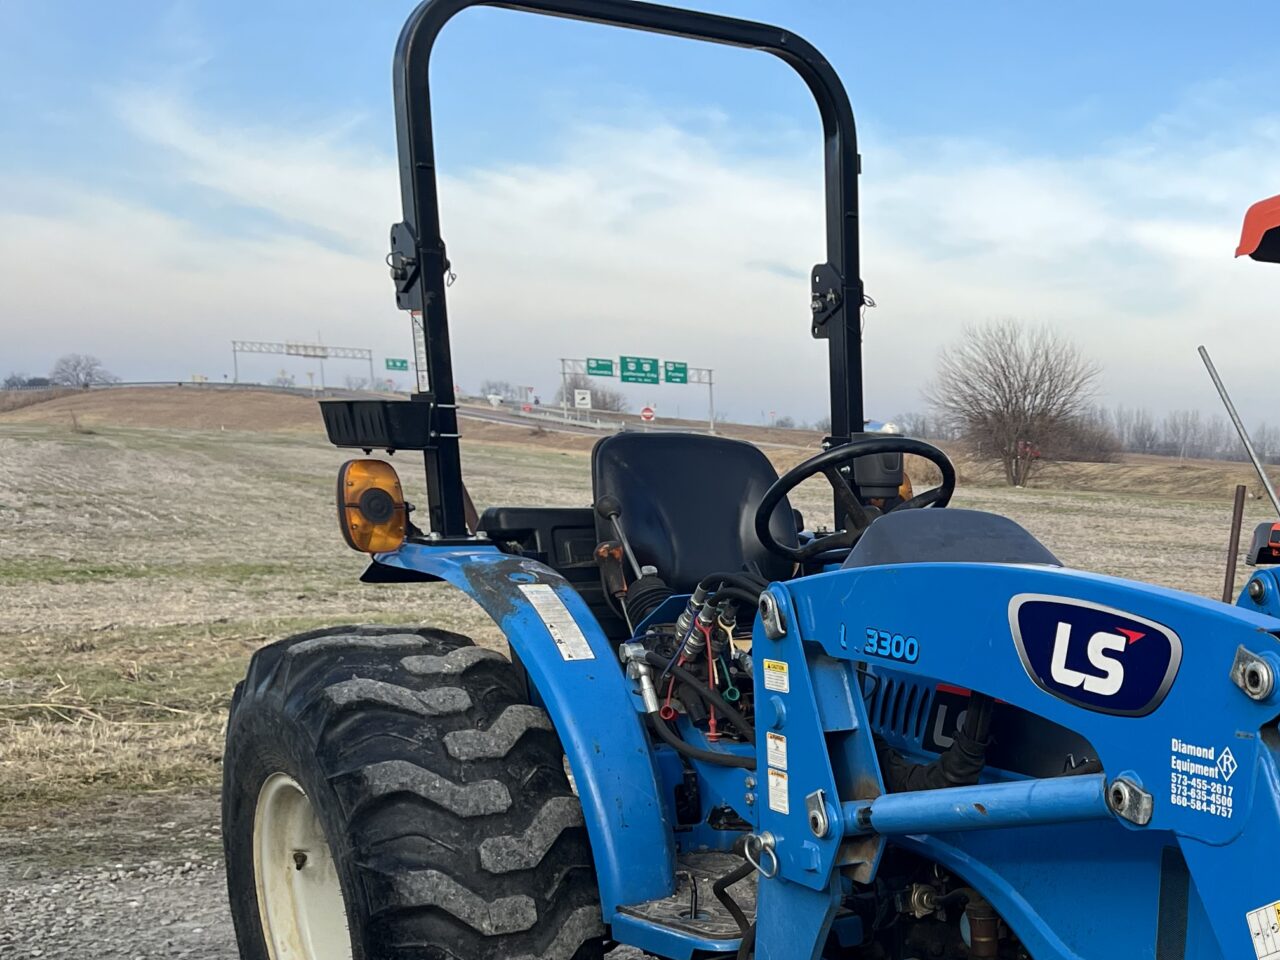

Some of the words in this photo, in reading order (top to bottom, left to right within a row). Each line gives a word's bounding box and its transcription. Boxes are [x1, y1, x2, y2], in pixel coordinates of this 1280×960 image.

[1050, 621, 1127, 696] LS
[1171, 738, 1215, 760] Diamond
[1171, 755, 1219, 779] Equipment
[1170, 783, 1233, 808] 573-635-4500
[1171, 773, 1234, 797] 573-455-2617
[1170, 794, 1233, 818] 660-584-8757
